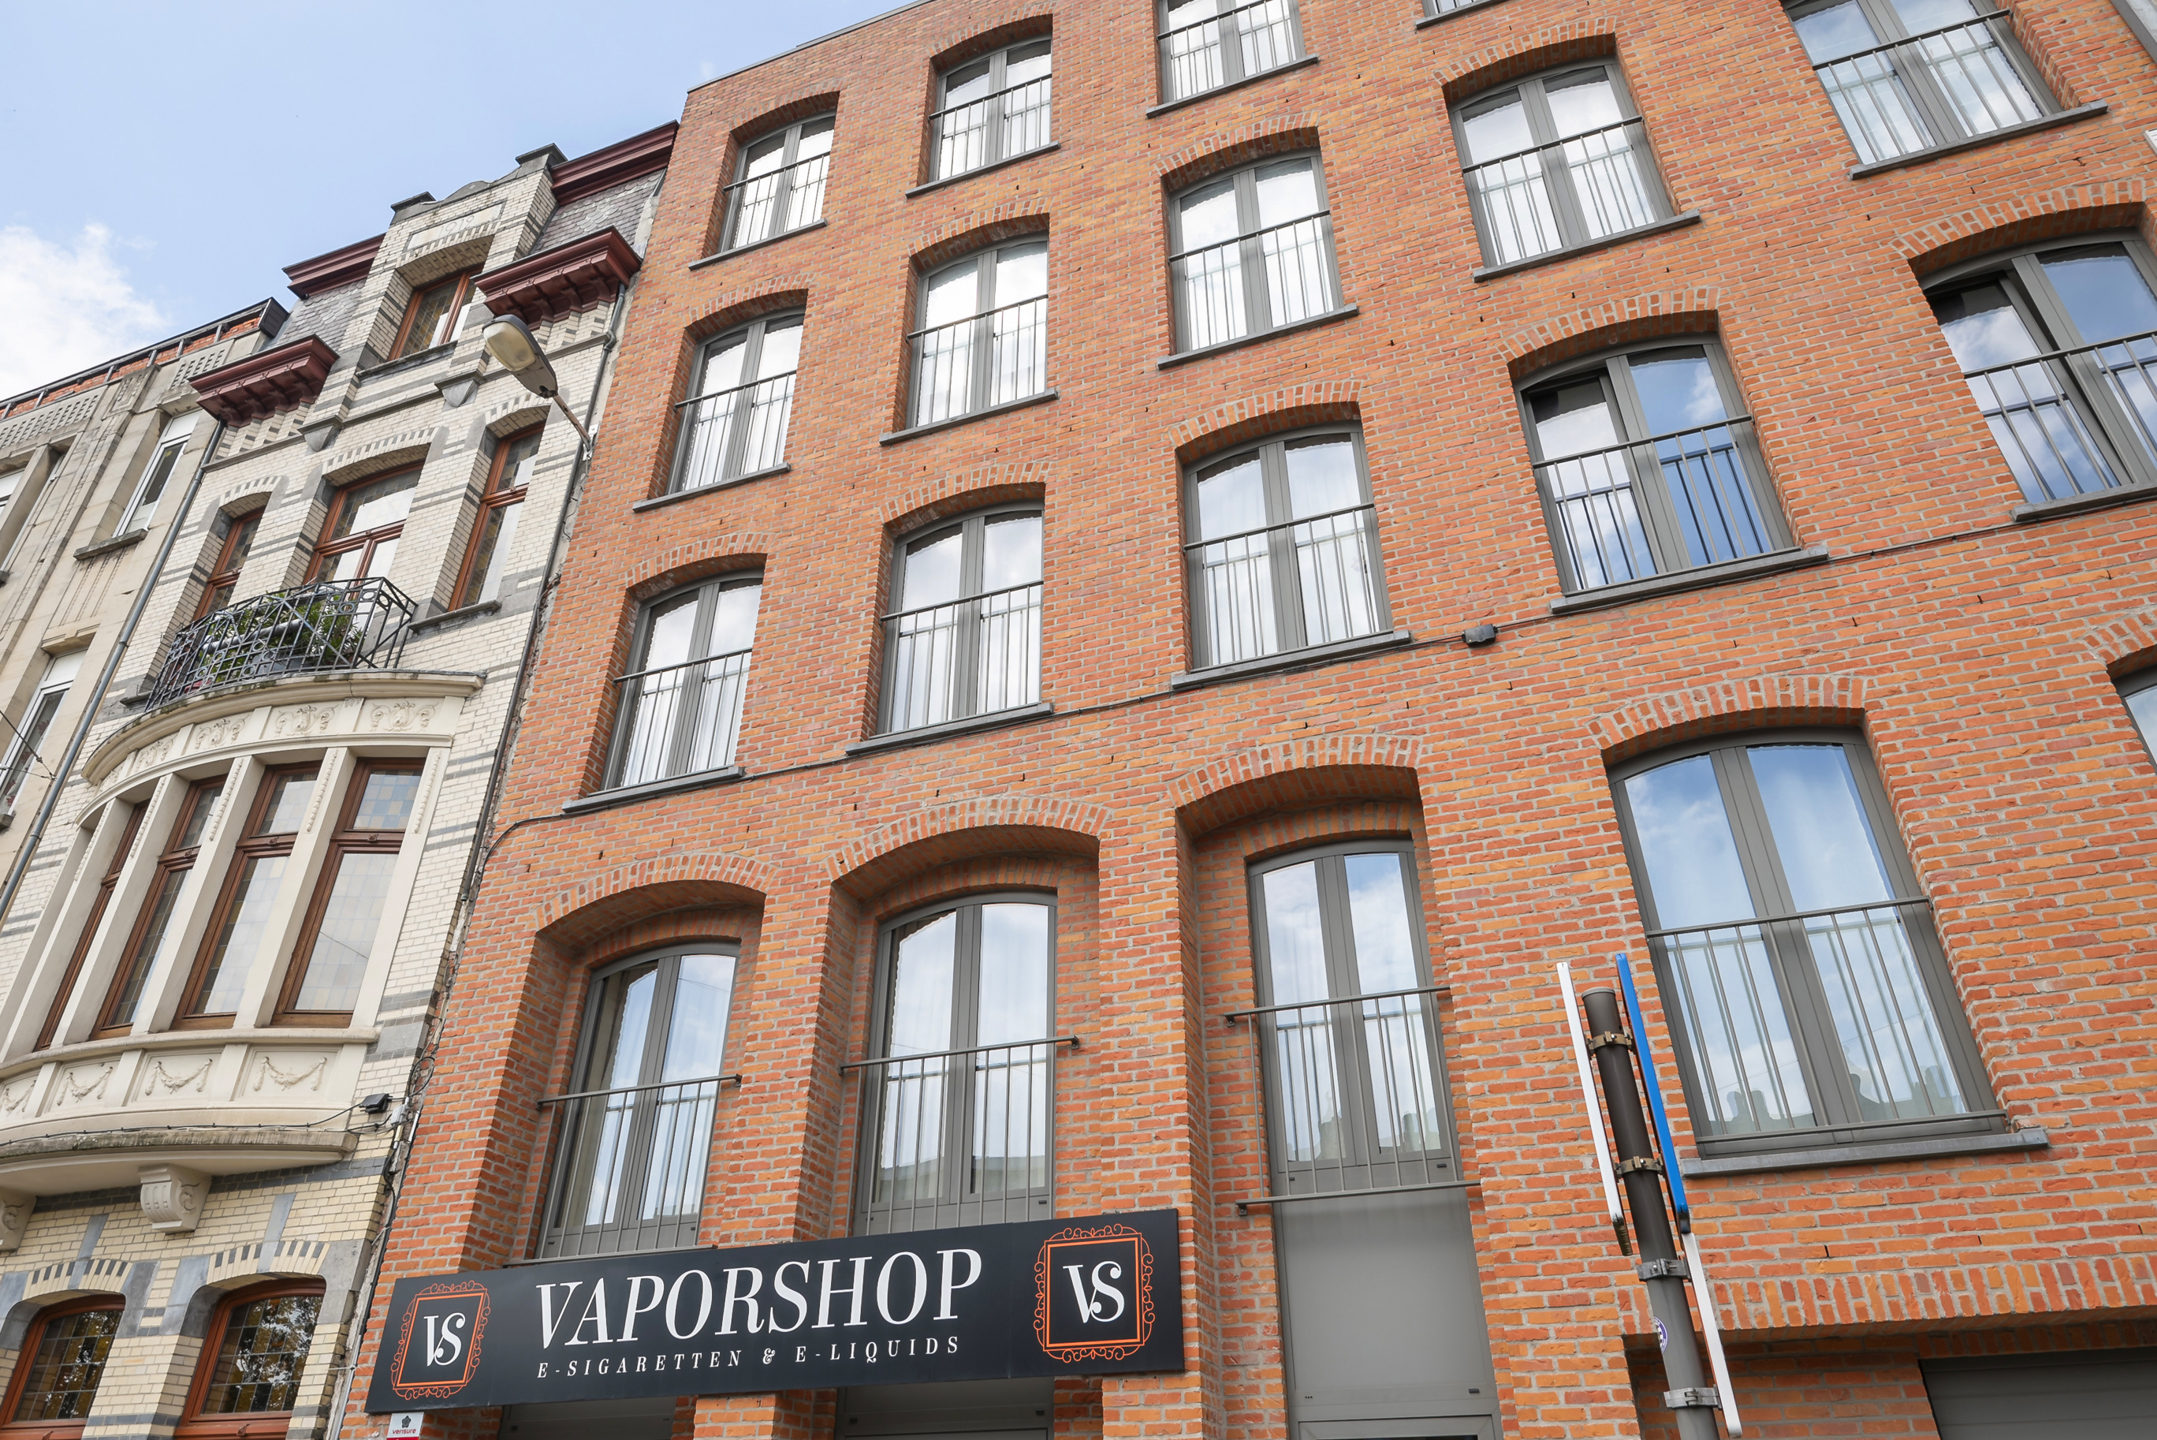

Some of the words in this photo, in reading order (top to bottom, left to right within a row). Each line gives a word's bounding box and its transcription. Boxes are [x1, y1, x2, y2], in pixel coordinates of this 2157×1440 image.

[535, 1248, 982, 1350] VAPORSHOP
[1062, 1260, 1125, 1324] VS
[423, 1312, 466, 1367] VS
[537, 1349, 742, 1379] E-SIGARETTEN
[762, 1347, 776, 1365] &
[795, 1335, 959, 1364] E-LIQUIDS
